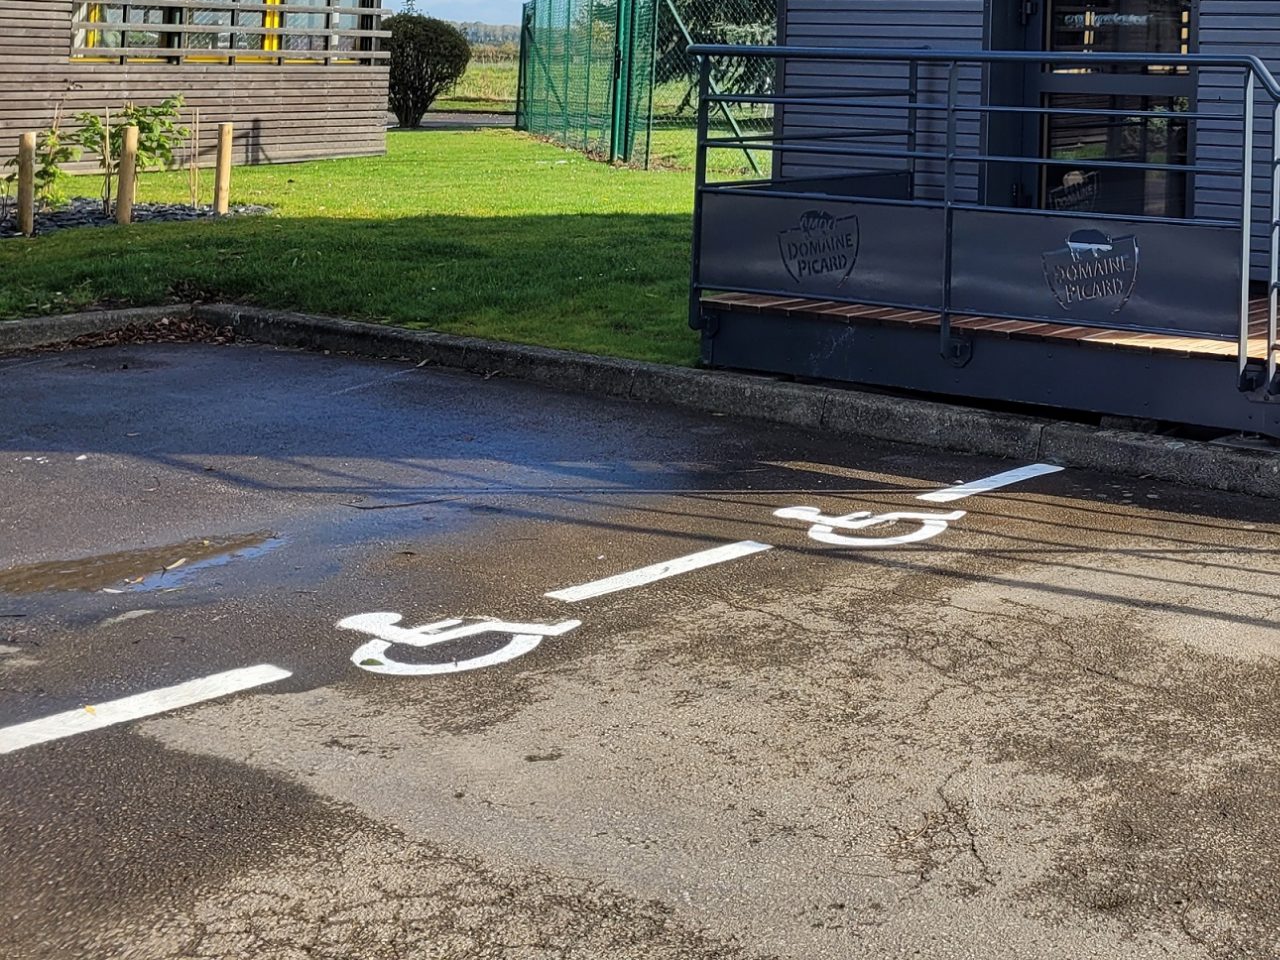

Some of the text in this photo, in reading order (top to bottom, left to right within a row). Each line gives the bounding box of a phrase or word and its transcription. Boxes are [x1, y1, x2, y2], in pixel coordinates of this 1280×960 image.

[787, 233, 853, 261] DOMAINE
[798, 254, 847, 277] PICARD
[1054, 255, 1131, 284] DOMAINE
[1065, 278, 1123, 303] PICARD
